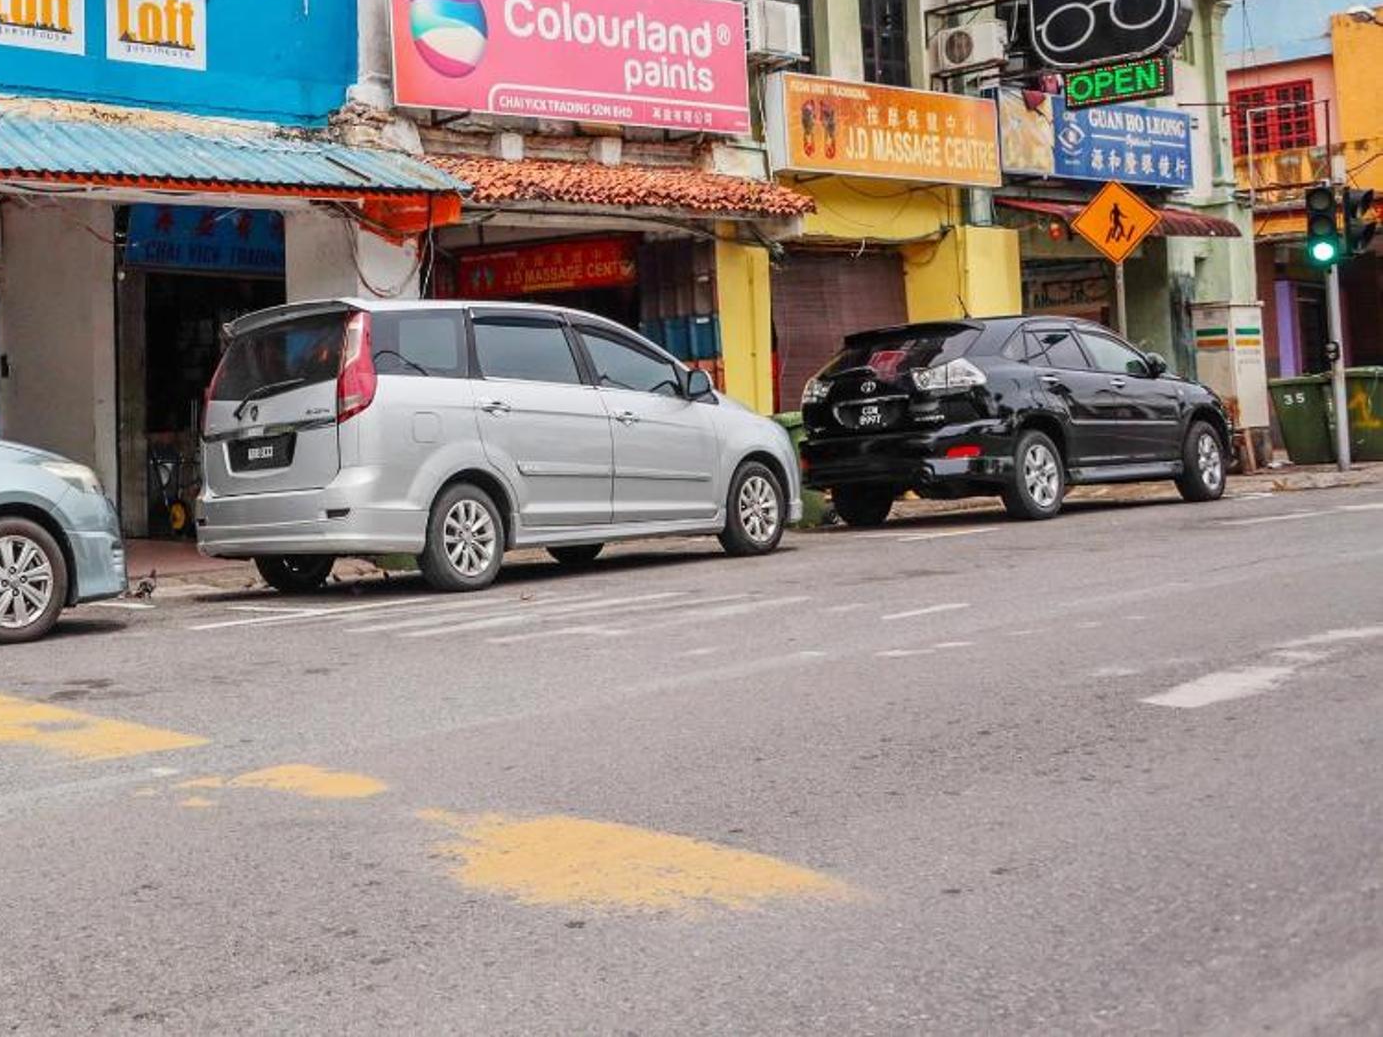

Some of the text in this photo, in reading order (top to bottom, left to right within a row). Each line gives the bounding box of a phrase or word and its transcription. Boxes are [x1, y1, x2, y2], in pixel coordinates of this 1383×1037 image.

[624, 57, 714, 93] paints
[1070, 62, 1157, 101] OPEN
[873, 130, 943, 166] MASSAGE
[944, 137, 997, 170] CENTRE
